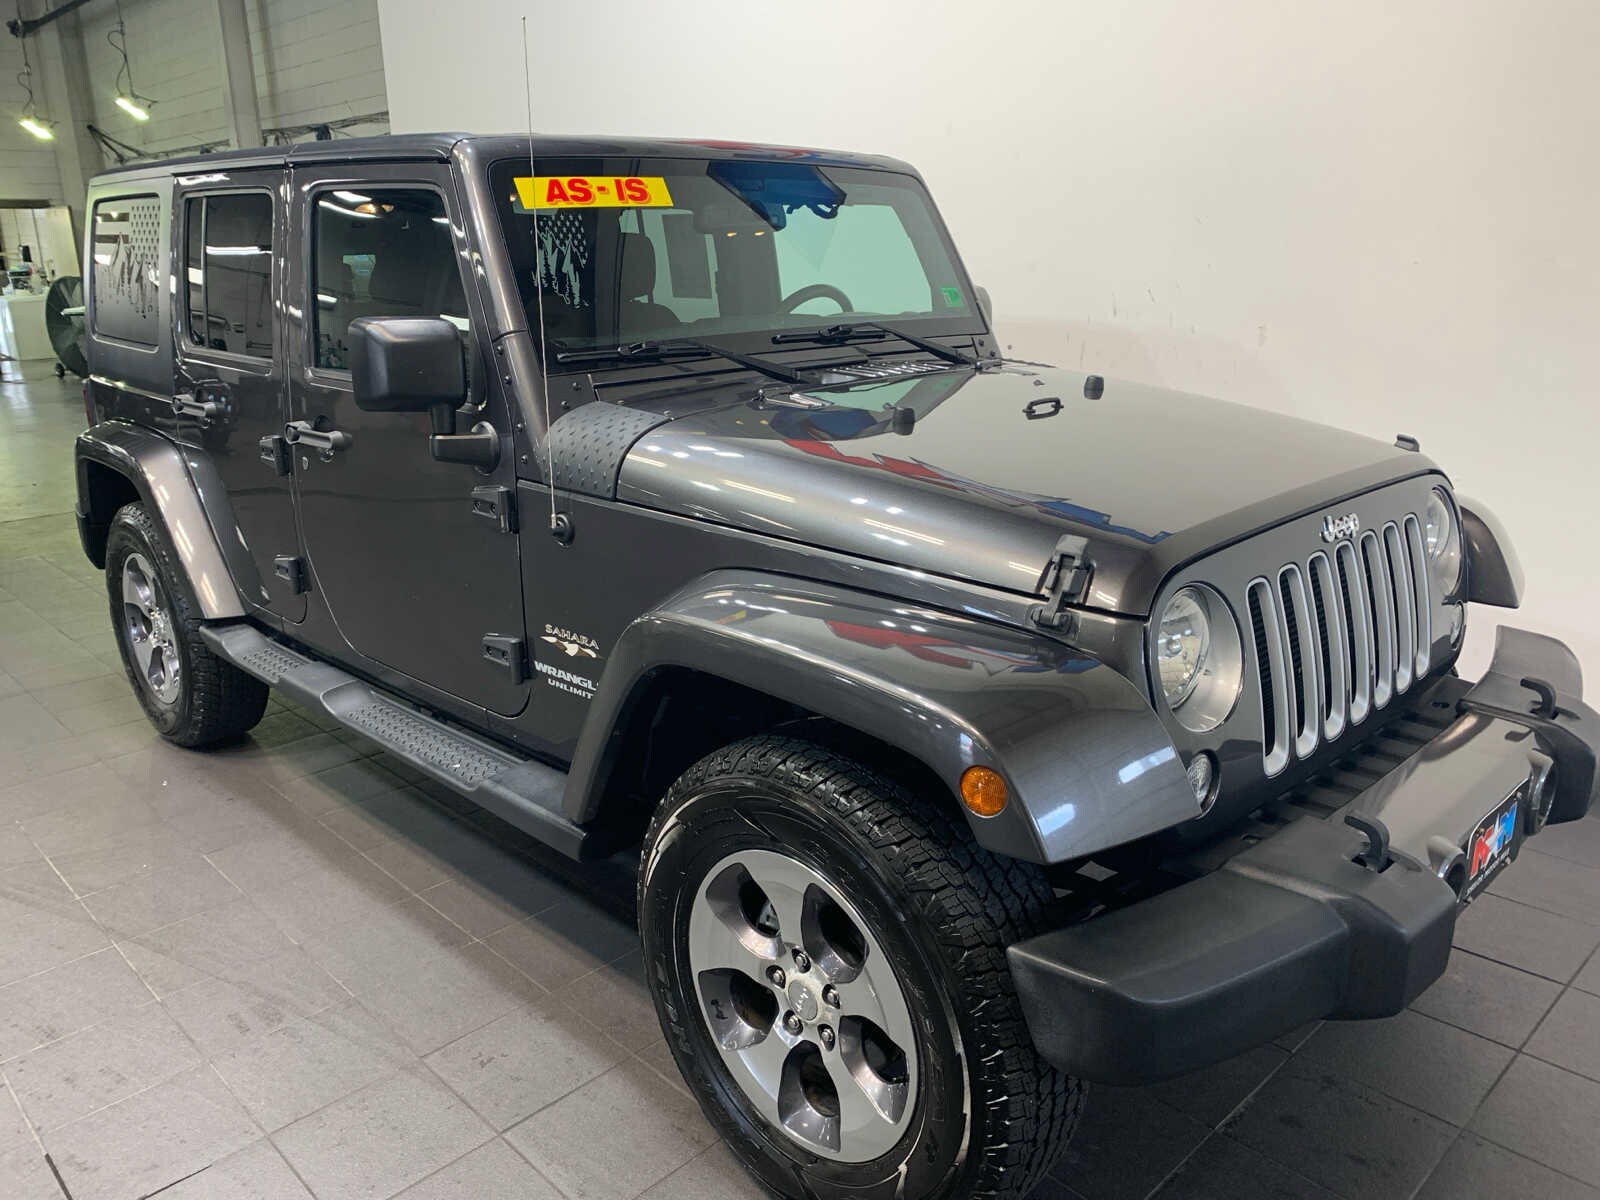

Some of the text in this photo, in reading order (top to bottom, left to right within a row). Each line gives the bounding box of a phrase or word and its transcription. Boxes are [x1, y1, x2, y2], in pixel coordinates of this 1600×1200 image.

[1321, 512, 1360, 542] Jeep
[544, 623, 600, 651] SAHARA
[534, 660, 599, 692] WRANGL
[547, 678, 594, 700] UNLIMIT
